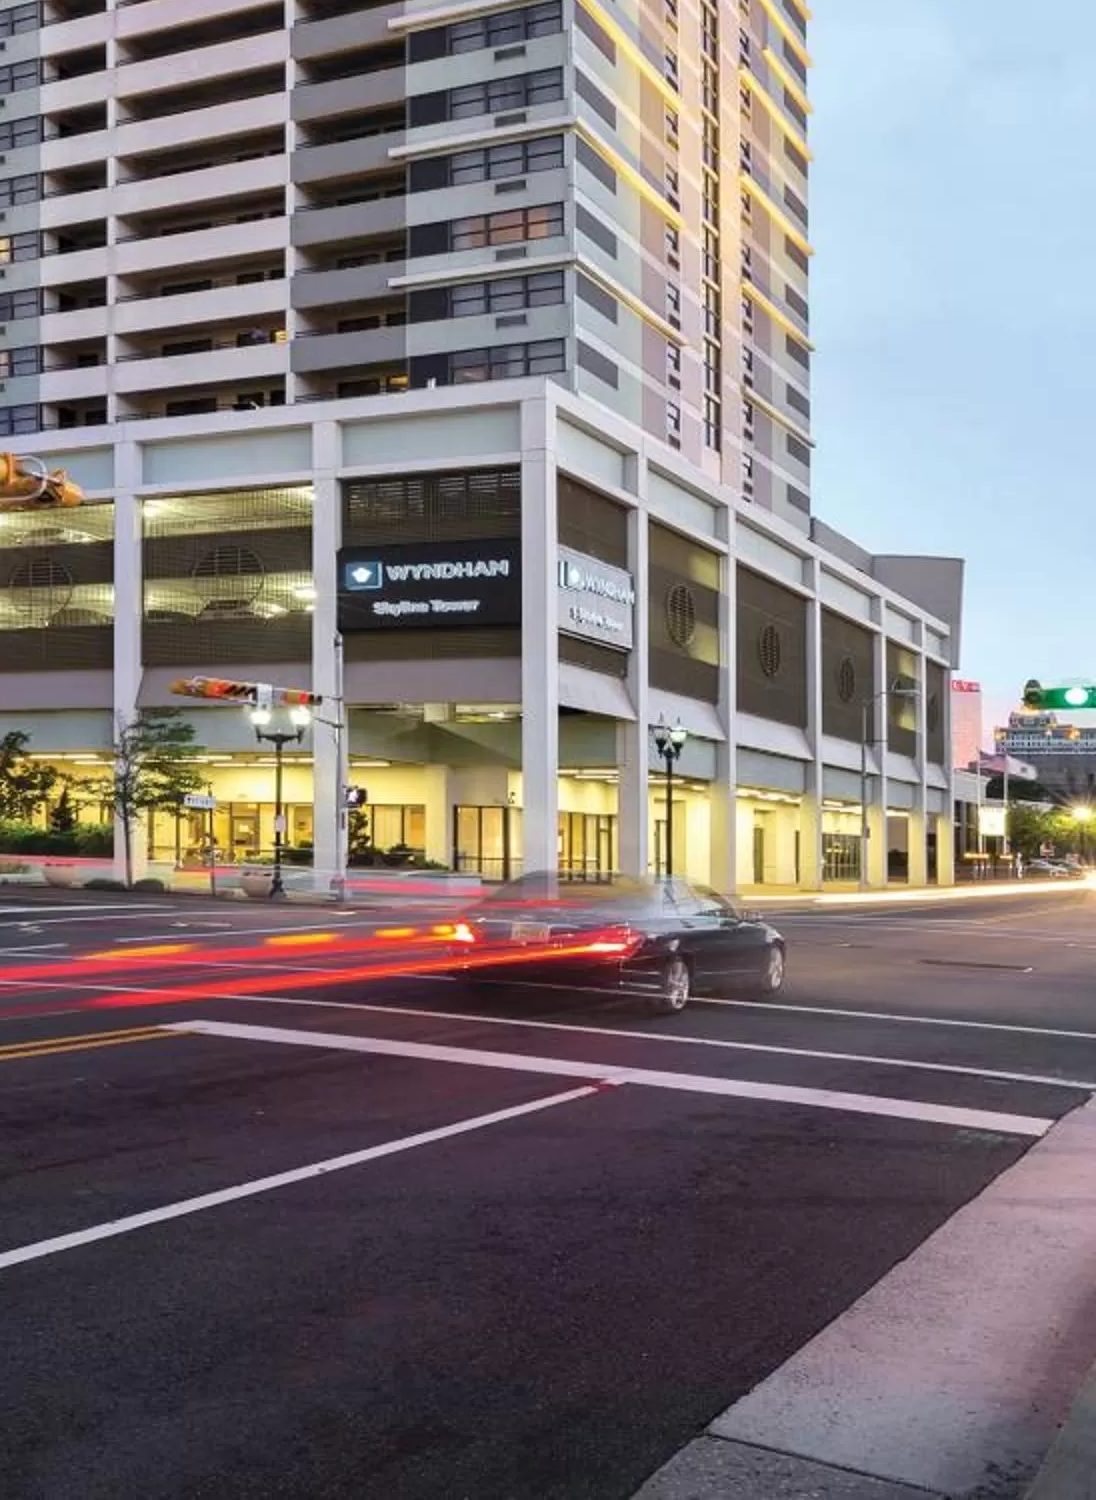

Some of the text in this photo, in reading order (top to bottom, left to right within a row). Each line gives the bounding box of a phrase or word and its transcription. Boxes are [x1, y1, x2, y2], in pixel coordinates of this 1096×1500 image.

[386, 560, 509, 581] WYNDHAM
[373, 599, 480, 617] Skyline Tower
